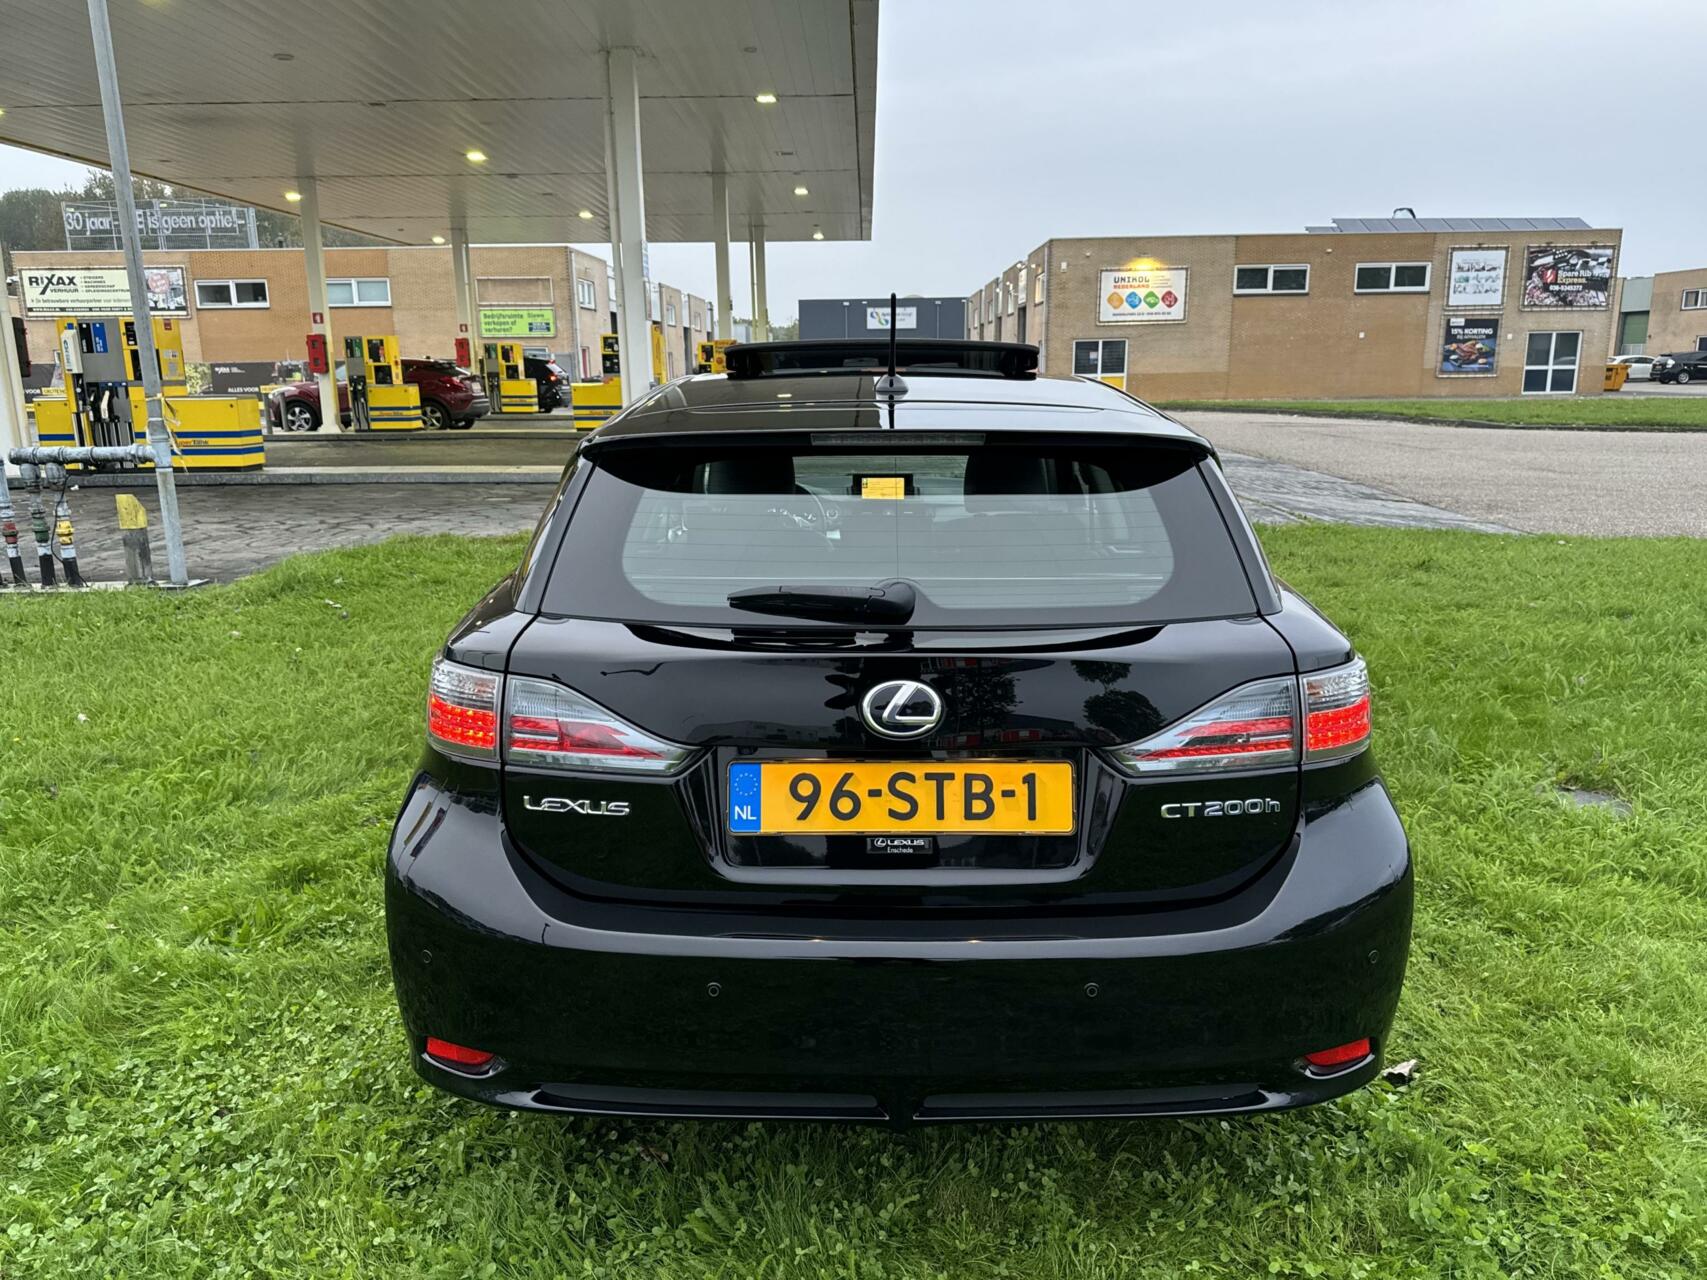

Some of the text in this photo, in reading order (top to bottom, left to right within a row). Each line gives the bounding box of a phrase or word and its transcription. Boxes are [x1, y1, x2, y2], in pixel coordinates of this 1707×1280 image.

[65, 212, 83, 230] 30
[162, 215, 195, 233] geen
[523, 795, 630, 816] LEXUS
[789, 772, 1037, 821] 96-STB-1
[734, 805, 757, 820] NL
[887, 846, 913, 854] Enschede
